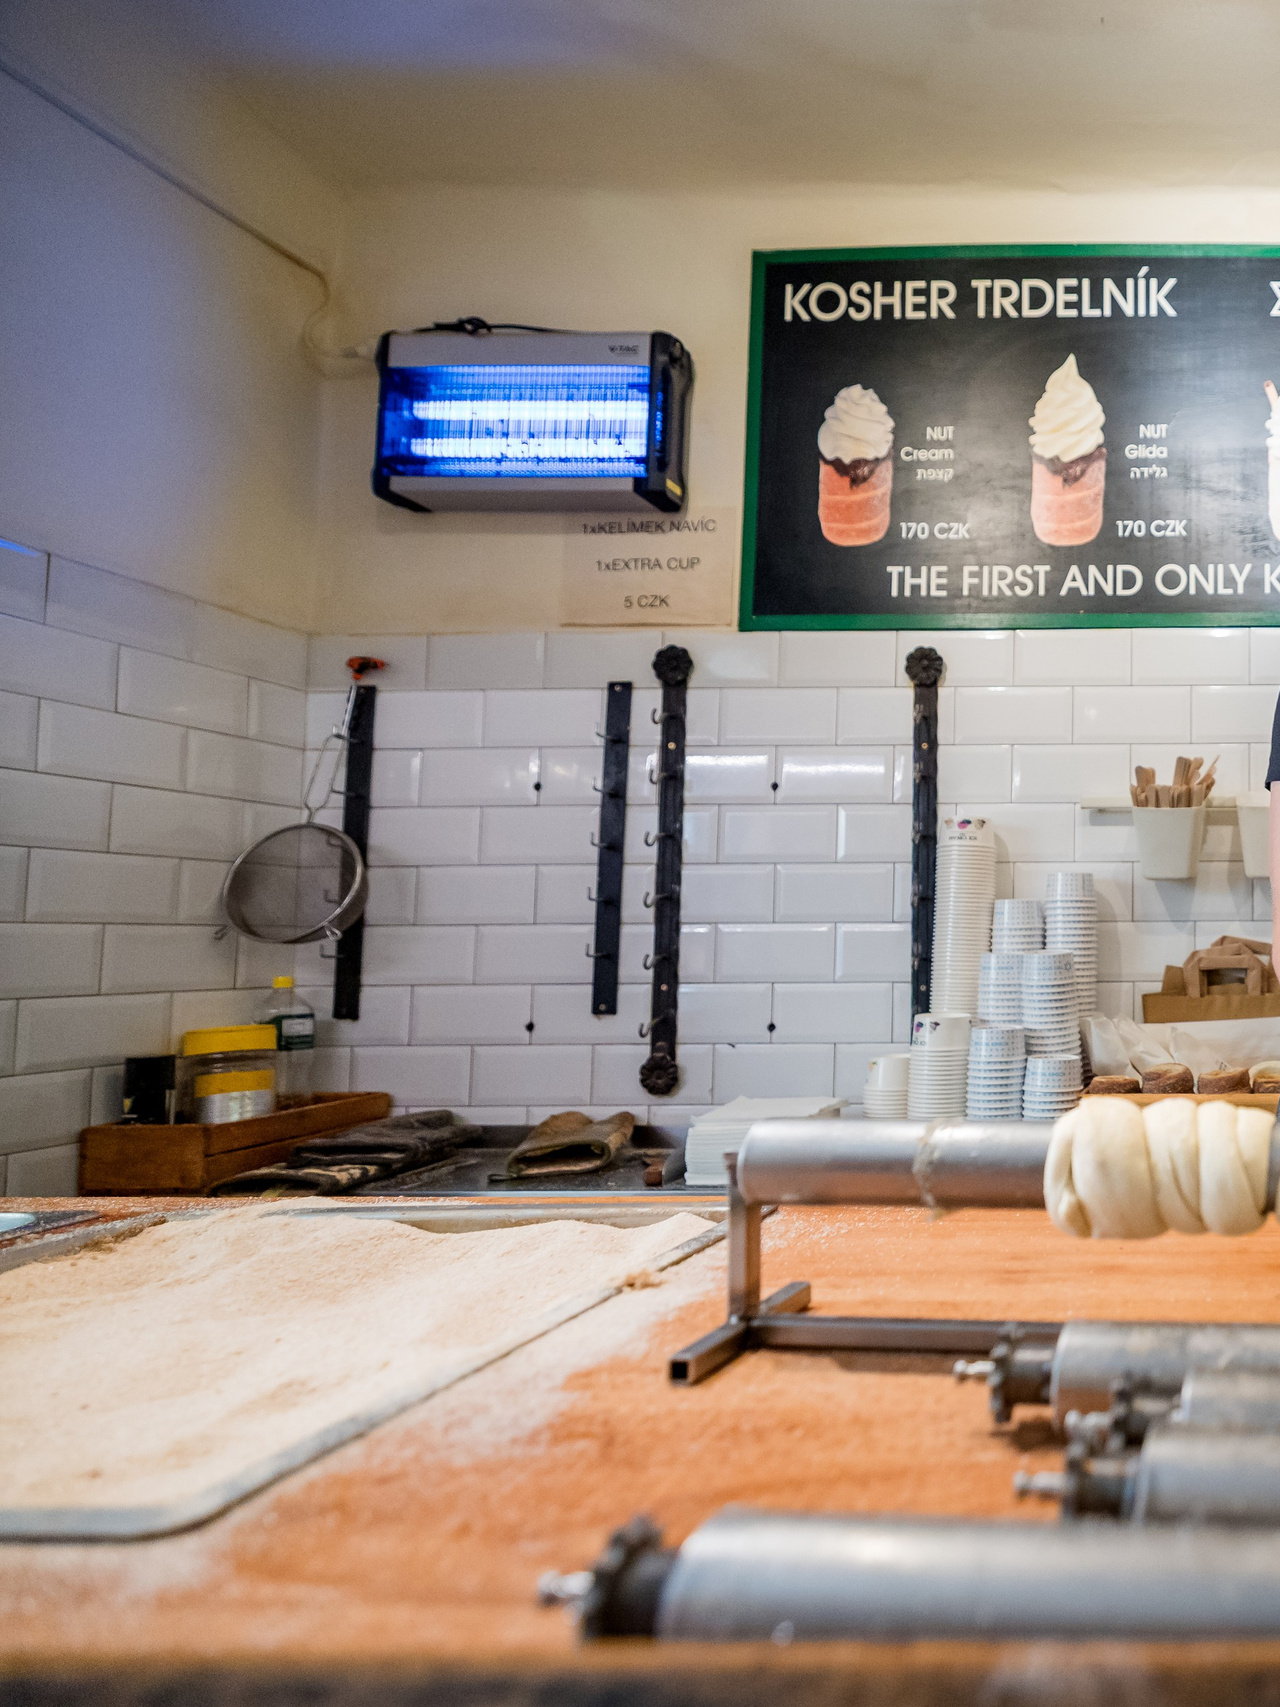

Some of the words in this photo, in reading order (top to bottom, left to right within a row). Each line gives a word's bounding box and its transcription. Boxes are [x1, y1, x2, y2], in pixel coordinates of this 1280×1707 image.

[783, 280, 957, 323] KOSHER
[971, 266, 1178, 319] TRDELNÍK
[926, 425, 955, 441] NUT
[1139, 423, 1168, 439] NUT
[900, 446, 955, 462] Cream
[1124, 443, 1168, 460] Glida
[916, 468, 955, 484] קצפת
[1129, 463, 1168, 480] גלידה
[900, 521, 929, 539] 170
[933, 521, 970, 539] CZK
[1116, 519, 1146, 538] 170
[1150, 519, 1188, 537] CZK
[666, 557, 701, 571] CUP
[887, 565, 948, 597] THE
[961, 564, 1051, 597] FIRST
[1060, 564, 1143, 596] AND
[1155, 562, 1252, 595] ONLY
[624, 596, 633, 609] 5
[637, 594, 670, 608] CZK
